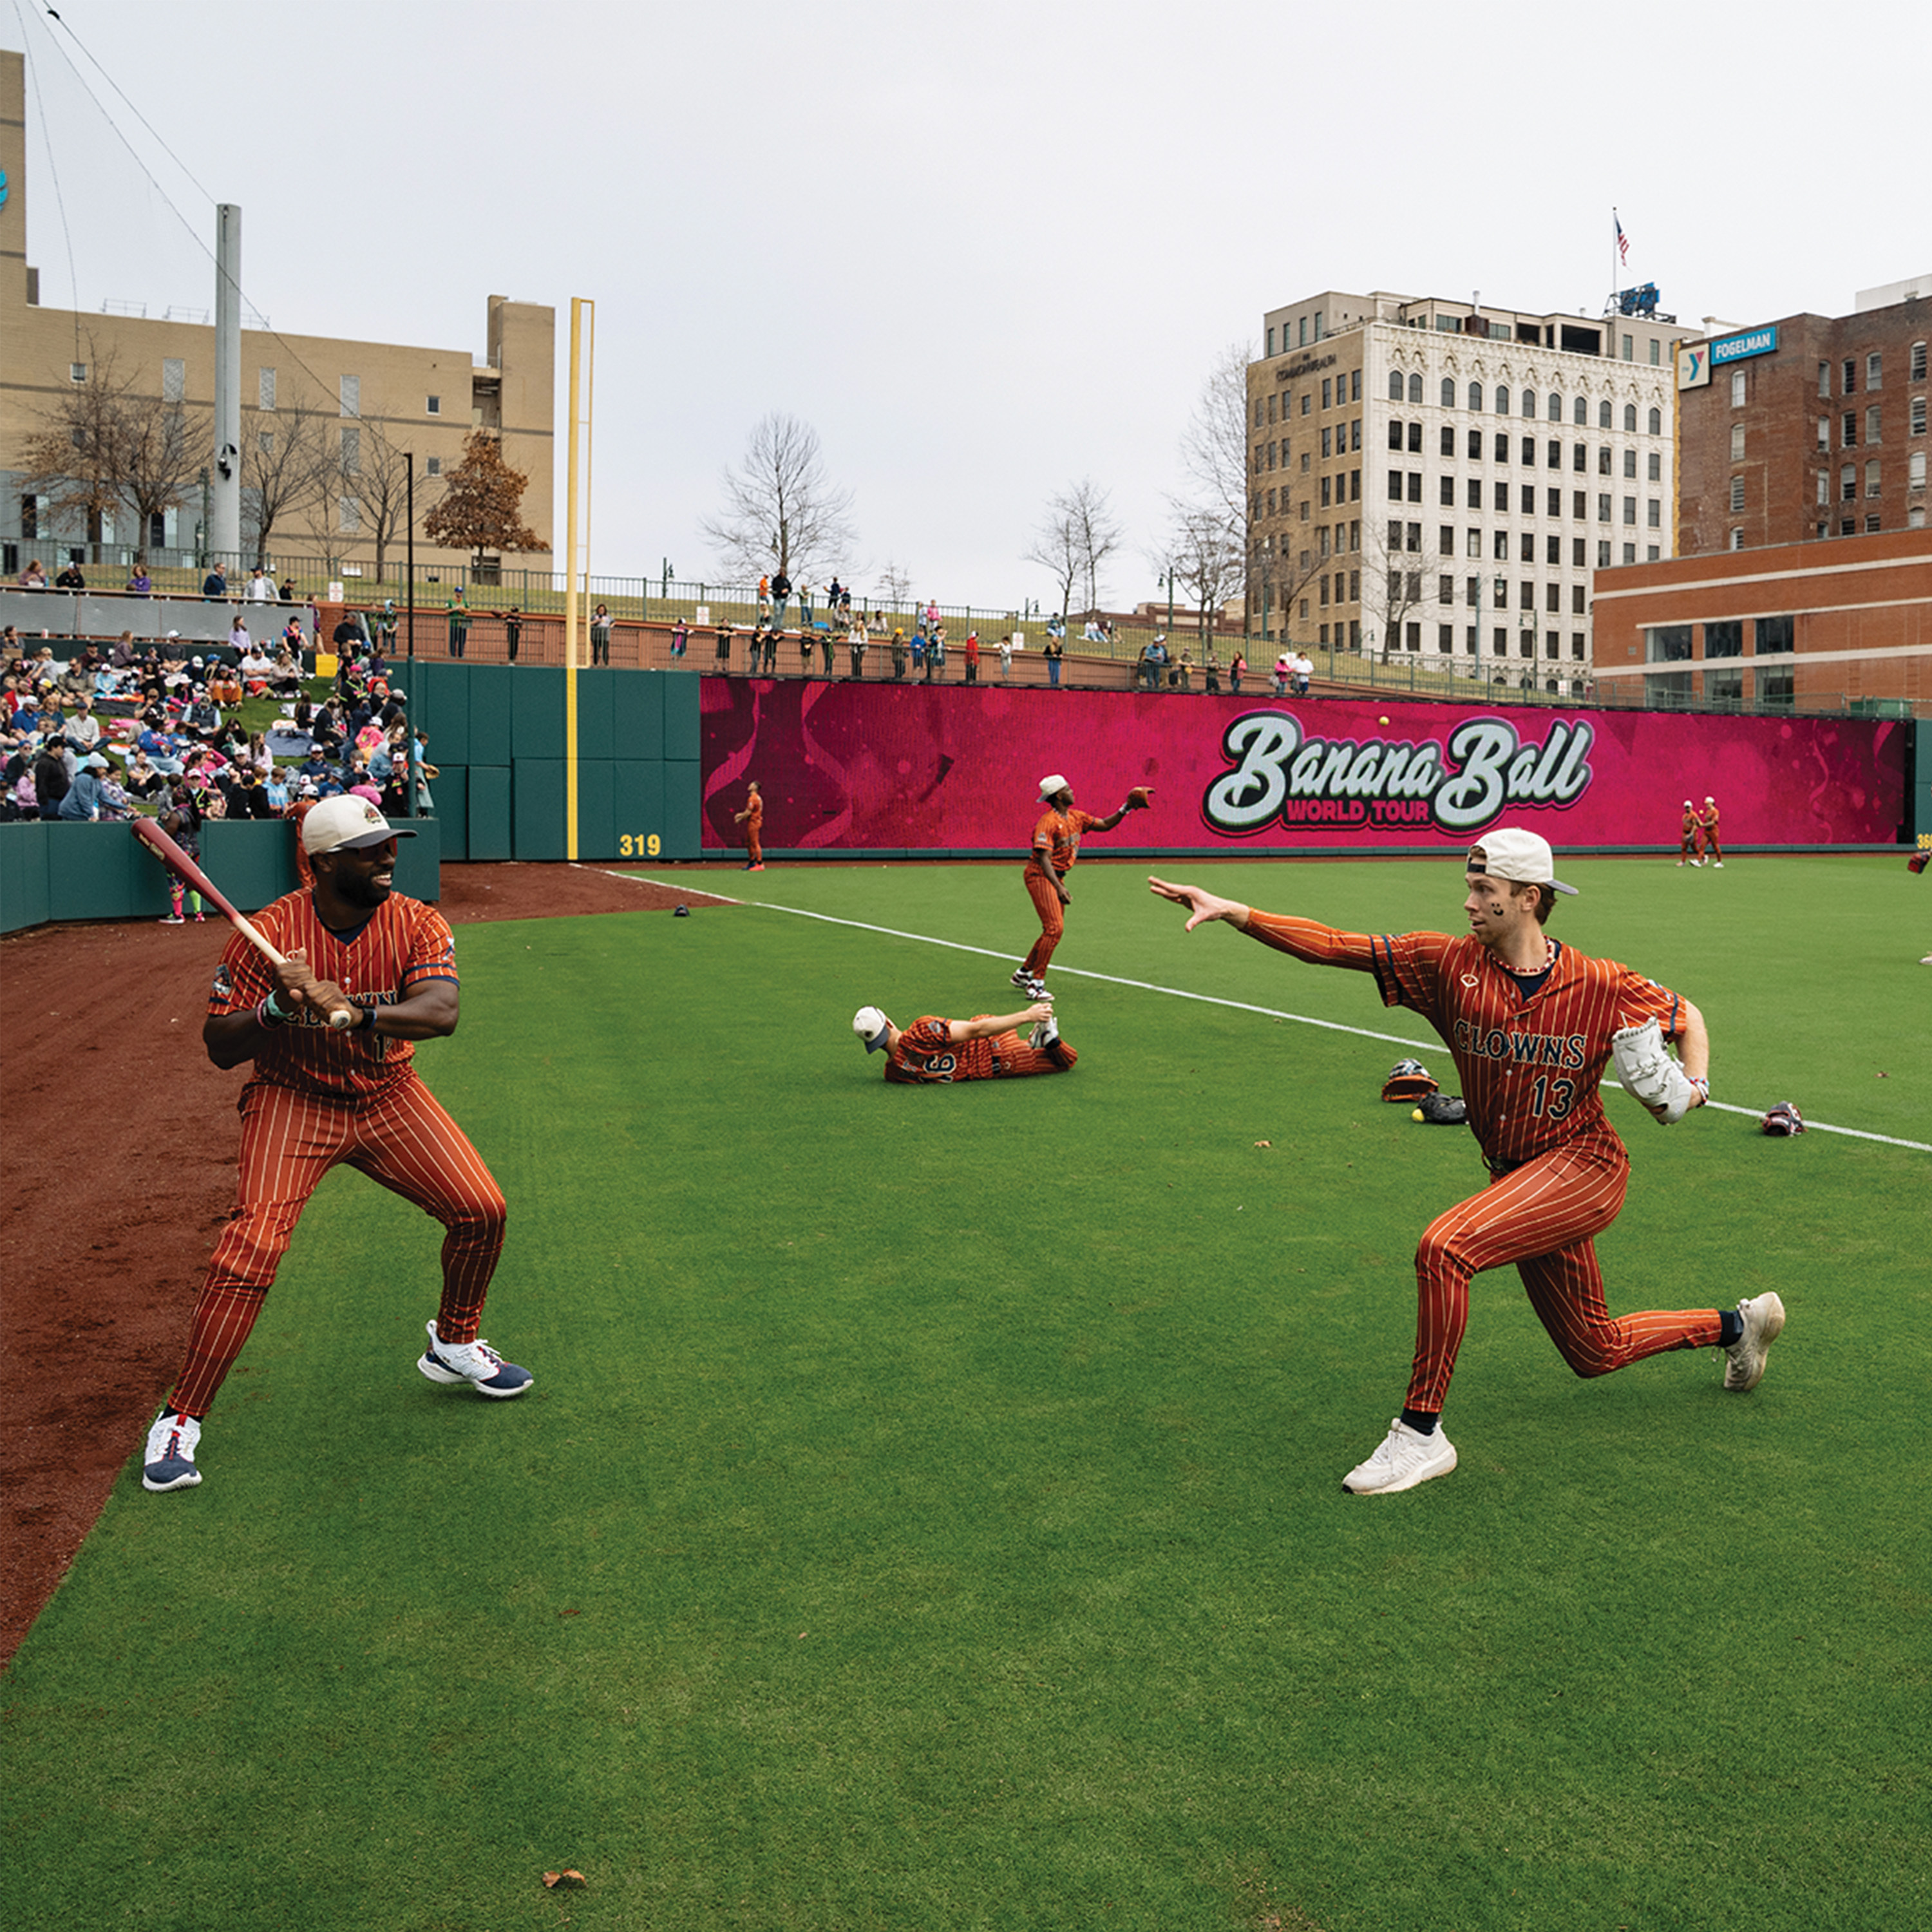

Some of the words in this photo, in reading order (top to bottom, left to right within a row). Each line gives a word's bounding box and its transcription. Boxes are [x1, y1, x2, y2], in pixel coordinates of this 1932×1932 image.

[1716, 332, 1770, 359] FOGELMAN
[1208, 716, 1441, 824] Banana
[1435, 724, 1586, 826] Ball
[1287, 799, 1365, 821] WORLD
[1371, 800, 1429, 821] TOUR
[620, 833, 661, 856] 319
[1917, 833, 1932, 849] 36
[1454, 1018, 1587, 1070] CLOWNS
[1533, 1075, 1576, 1119] 13
